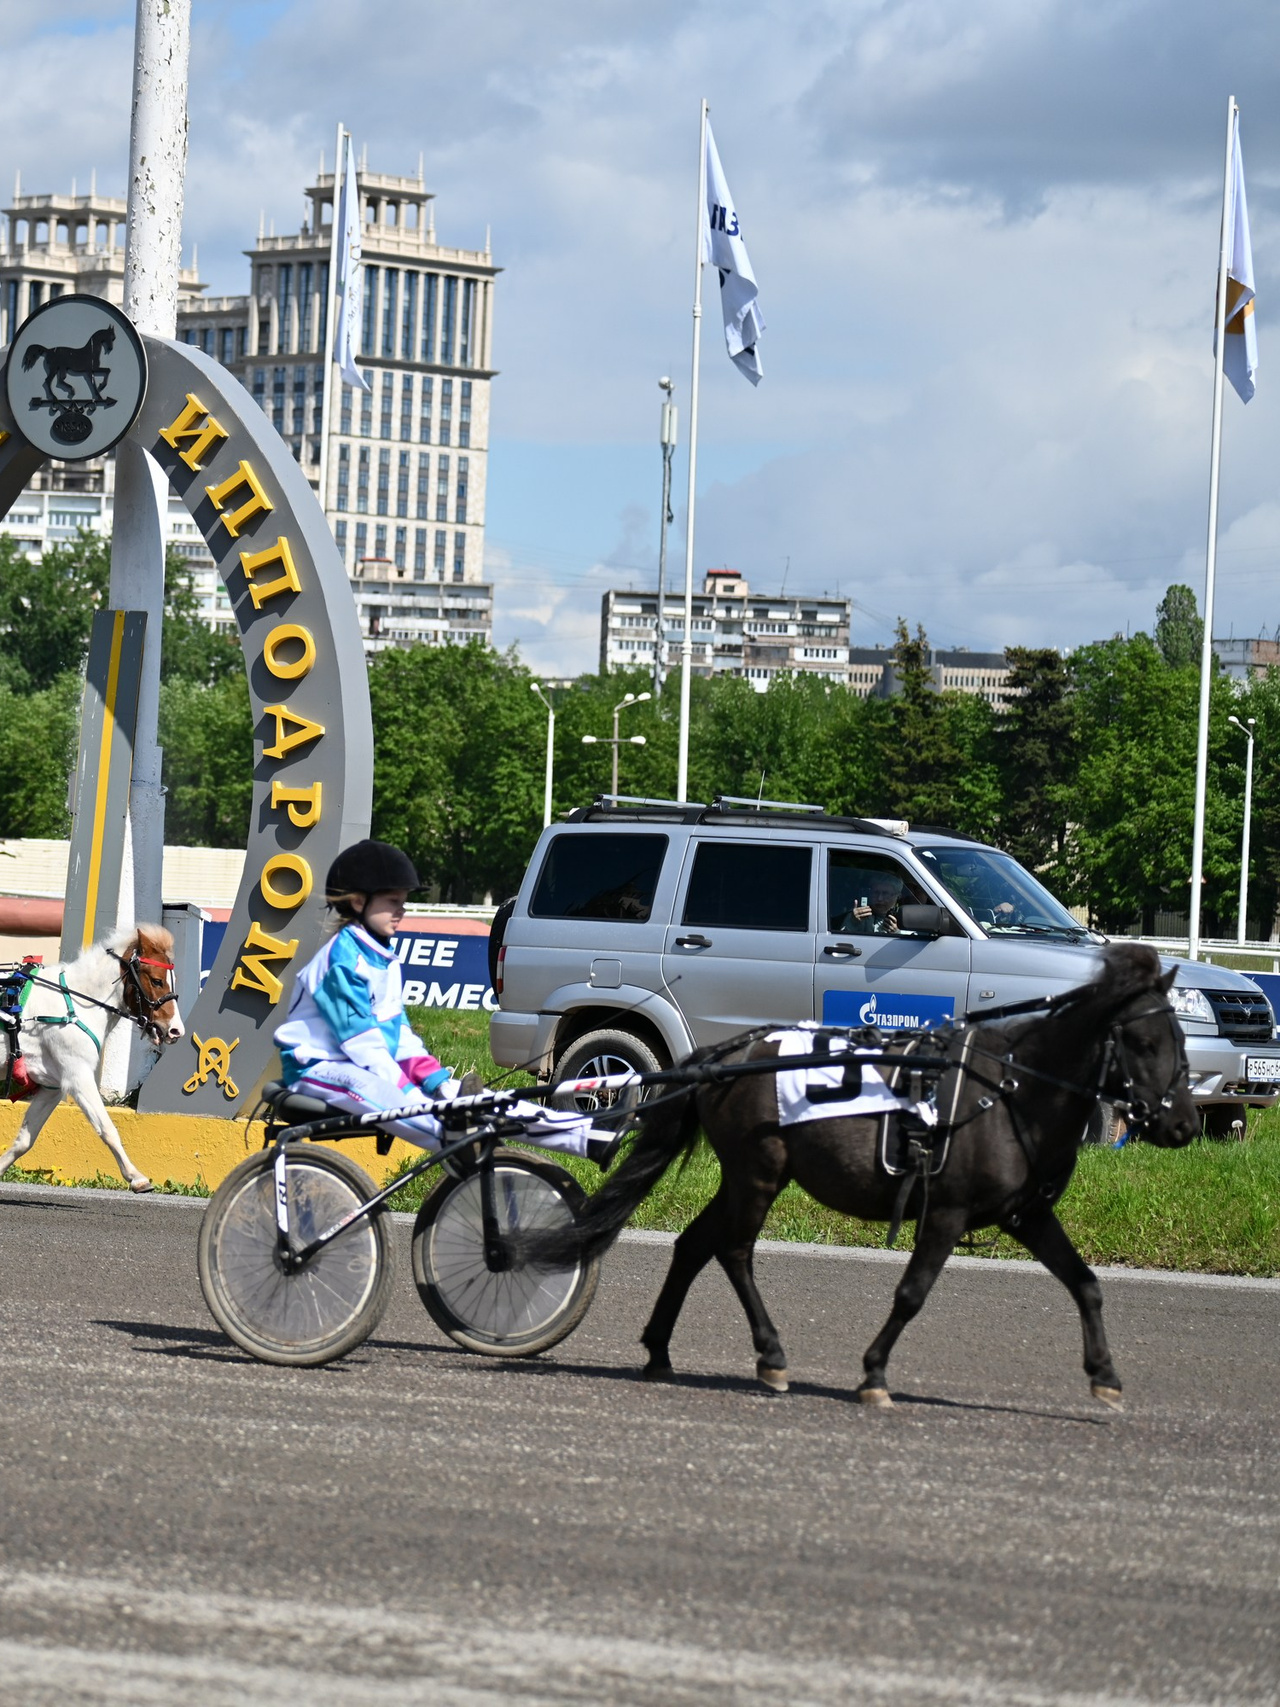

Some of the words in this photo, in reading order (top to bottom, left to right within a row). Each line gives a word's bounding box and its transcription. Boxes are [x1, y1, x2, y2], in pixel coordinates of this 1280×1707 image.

[160, 393, 326, 1004] ИППОДРОМ
[876, 1013, 919, 1028] ГАЗПРОМ
[360, 1088, 516, 1125] FINNTACK
